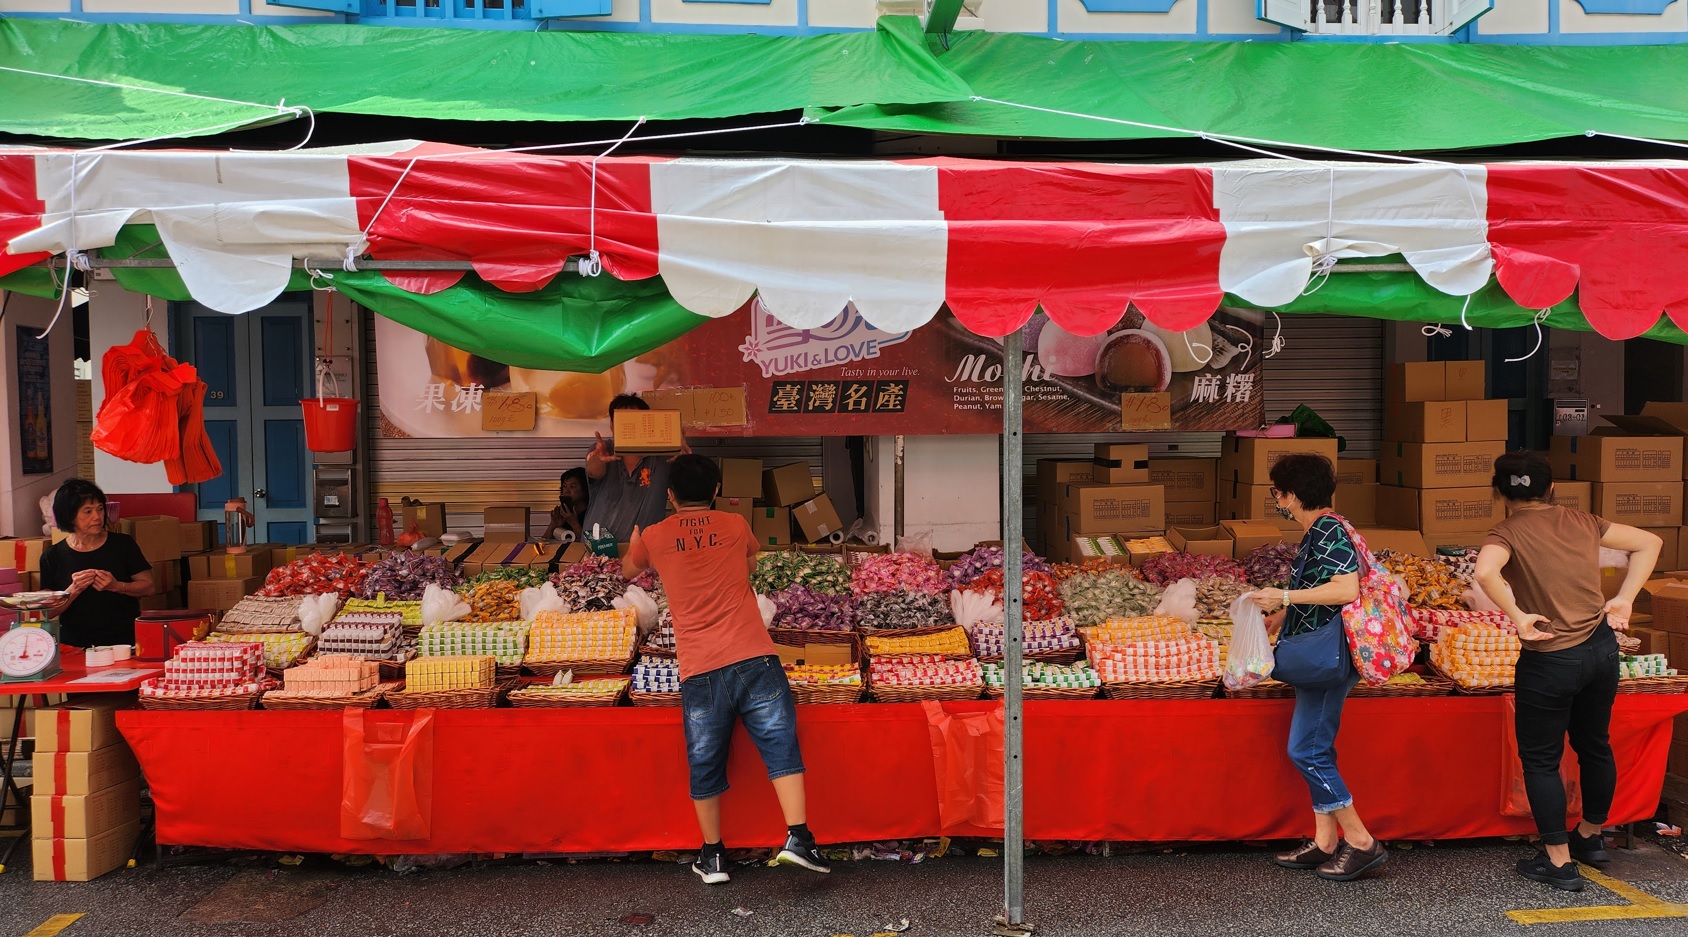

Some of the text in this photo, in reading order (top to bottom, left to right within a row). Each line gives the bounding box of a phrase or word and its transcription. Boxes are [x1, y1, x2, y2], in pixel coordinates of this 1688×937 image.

[761, 352, 809, 375] YUKI
[824, 339, 878, 364] LOVE
[840, 367, 920, 379] Tasty in your live.
[944, 353, 1057, 382] Mohi
[953, 386, 979, 394] Fruits,
[1024, 385, 1063, 393] Chestnut,
[1190, 373, 1255, 403] 麻糬
[210, 390, 224, 399] 39
[413, 382, 485, 414] 果凍
[771, 383, 904, 411] 臺灣名產
[953, 394, 983, 402] Durian,
[1038, 394, 1070, 402] Sesame,
[953, 403, 983, 411] Peanut,
[679, 515, 711, 527] FIGHT
[689, 528, 704, 536] FOR
[676, 533, 723, 552] N.Y.C.
